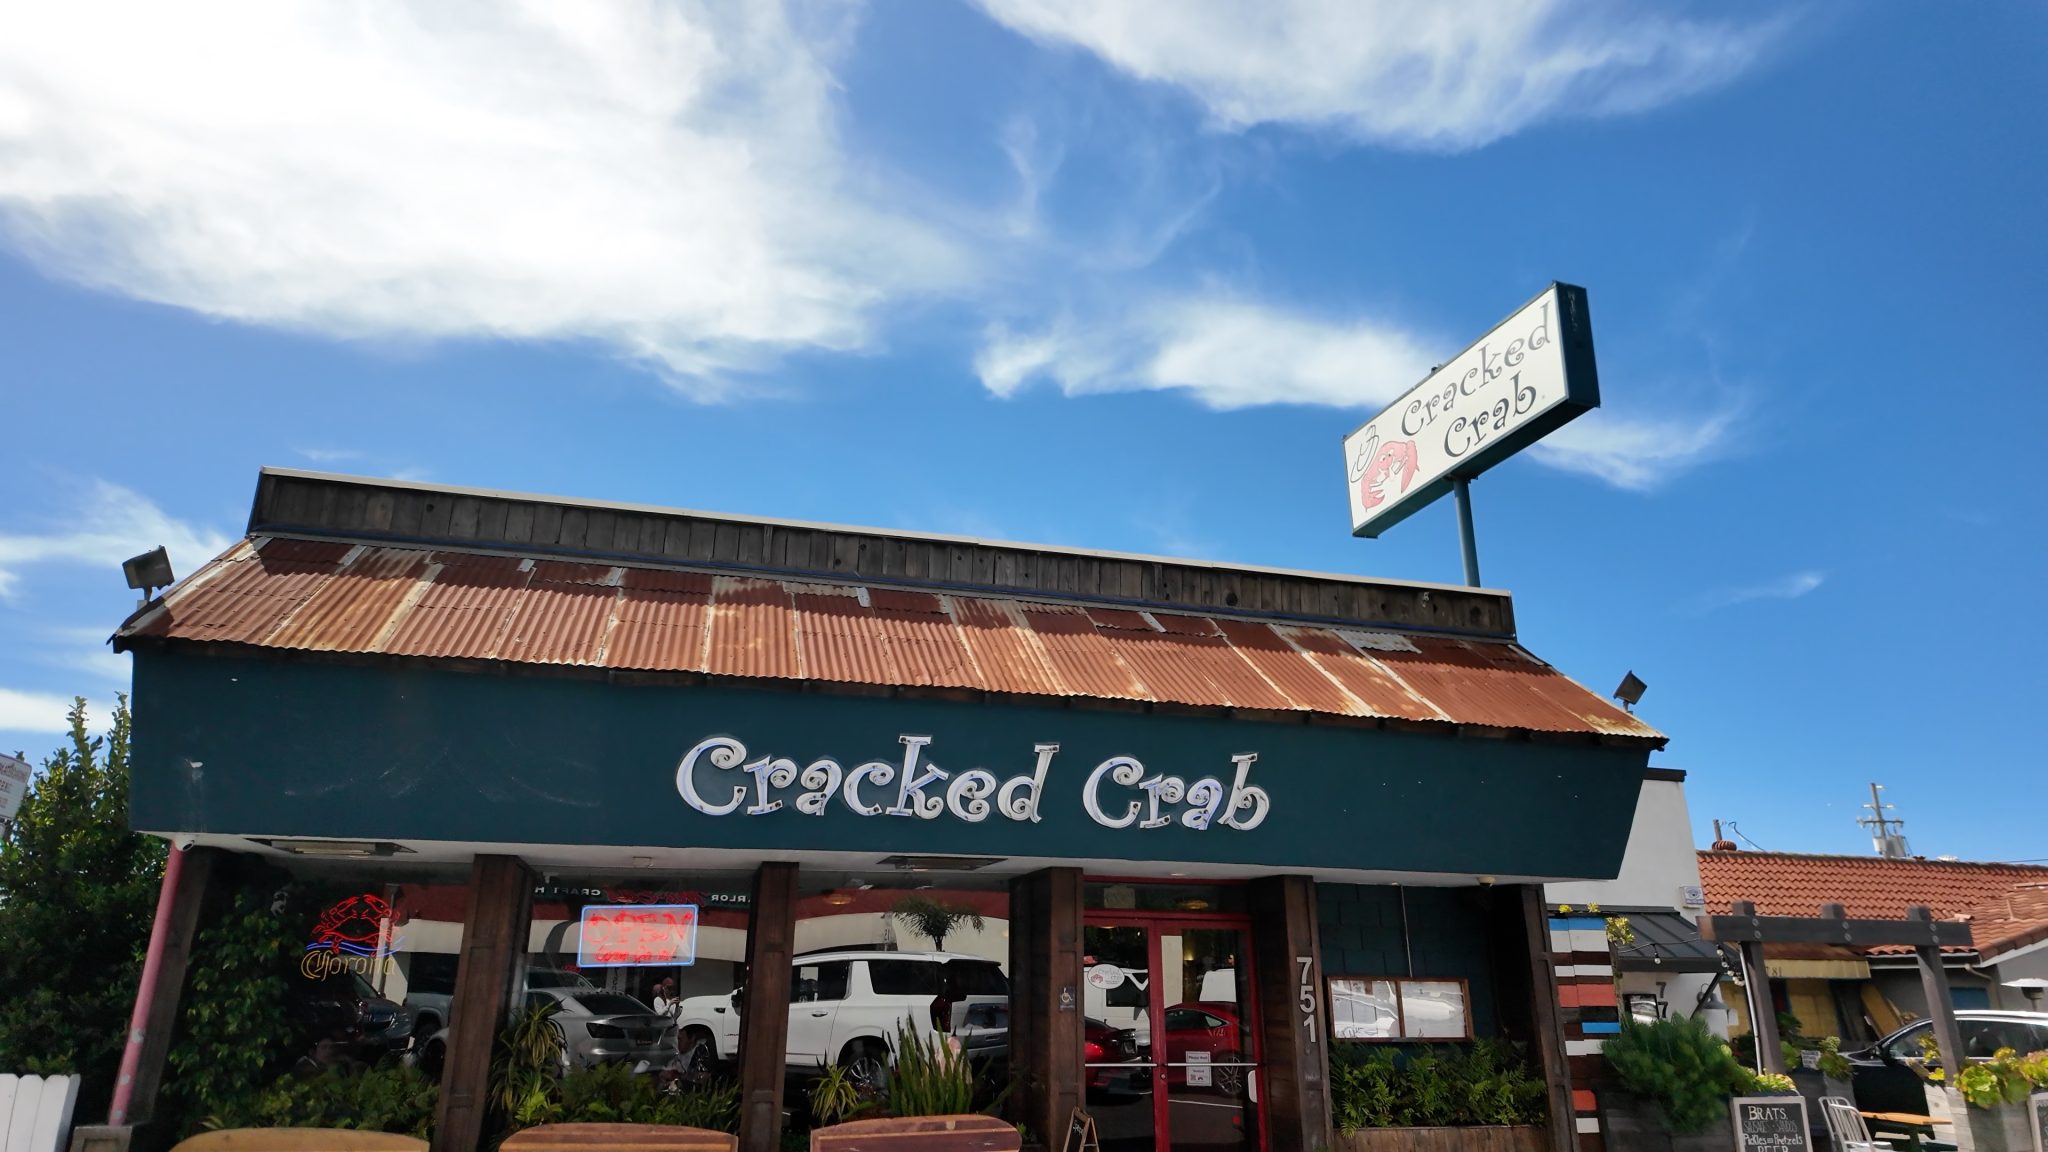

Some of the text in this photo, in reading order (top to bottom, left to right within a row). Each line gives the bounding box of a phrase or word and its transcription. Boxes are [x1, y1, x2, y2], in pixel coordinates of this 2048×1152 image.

[1401, 301, 1551, 437] Cracked
[1444, 370, 1537, 458] Crab
[676, 736, 1269, 831] Cracked Crab
[301, 951, 396, 981] Corona
[584, 911, 693, 944] OPEN
[1296, 957, 1317, 1043] 751
